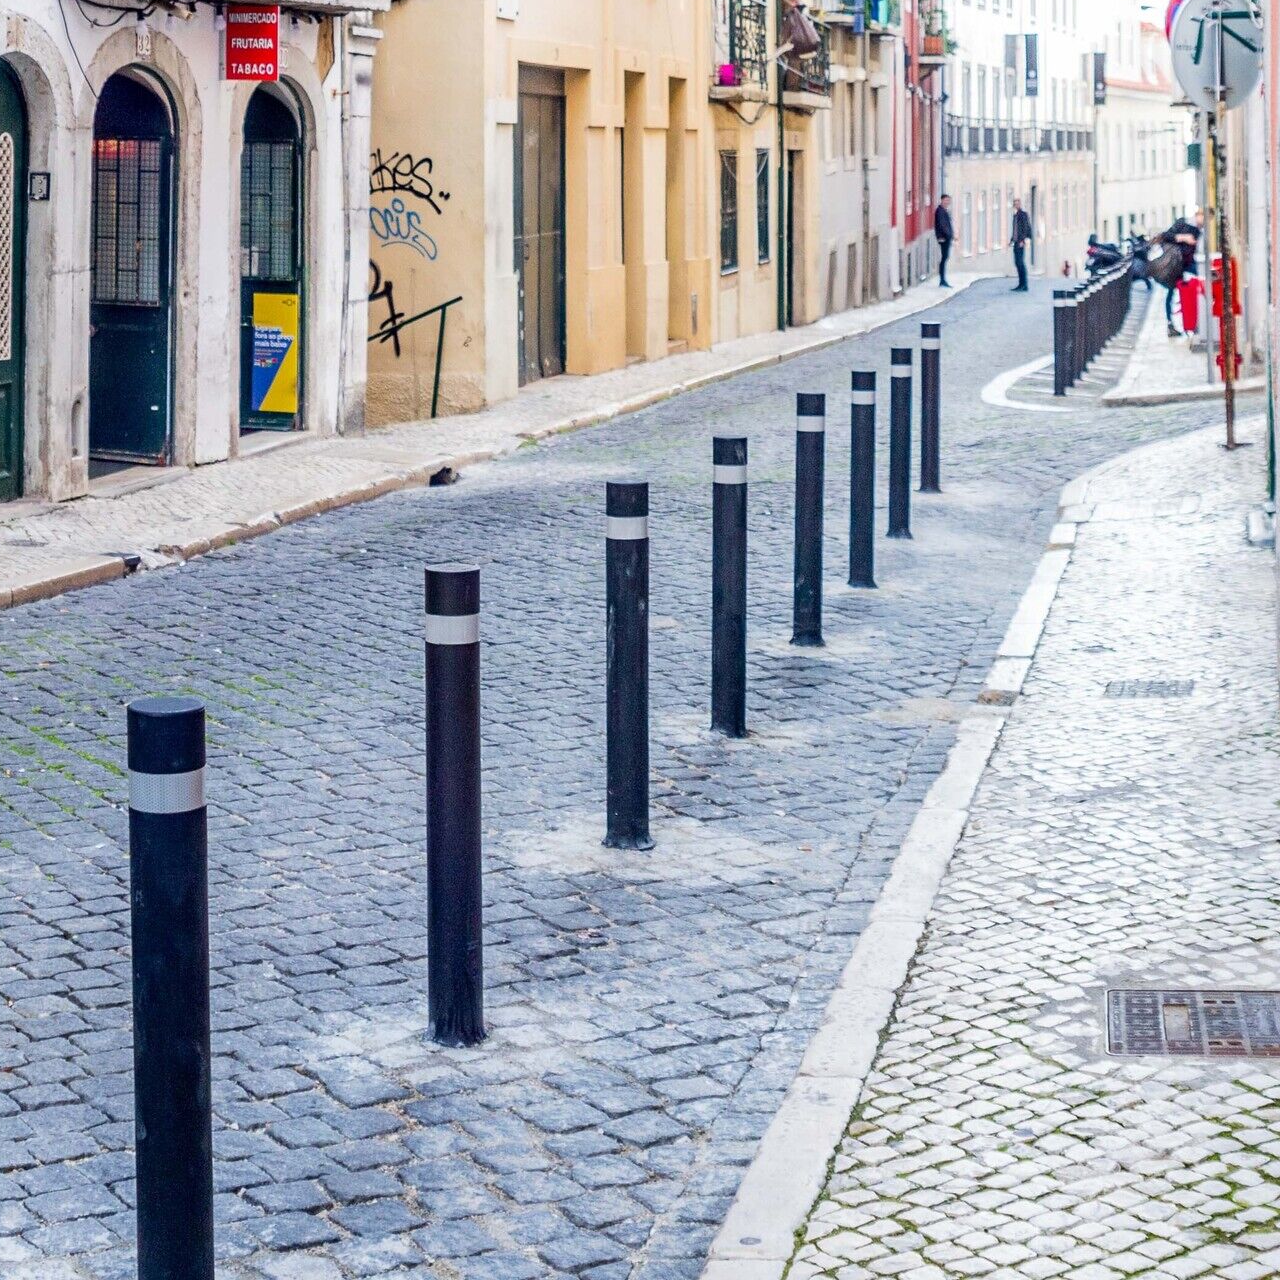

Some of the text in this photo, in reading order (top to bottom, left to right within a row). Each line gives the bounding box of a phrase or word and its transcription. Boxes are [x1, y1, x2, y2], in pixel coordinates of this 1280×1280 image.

[228, 12, 277, 24] MINIMERCADO
[231, 38, 274, 49] FRUTARIA
[231, 63, 274, 75] TABACO
